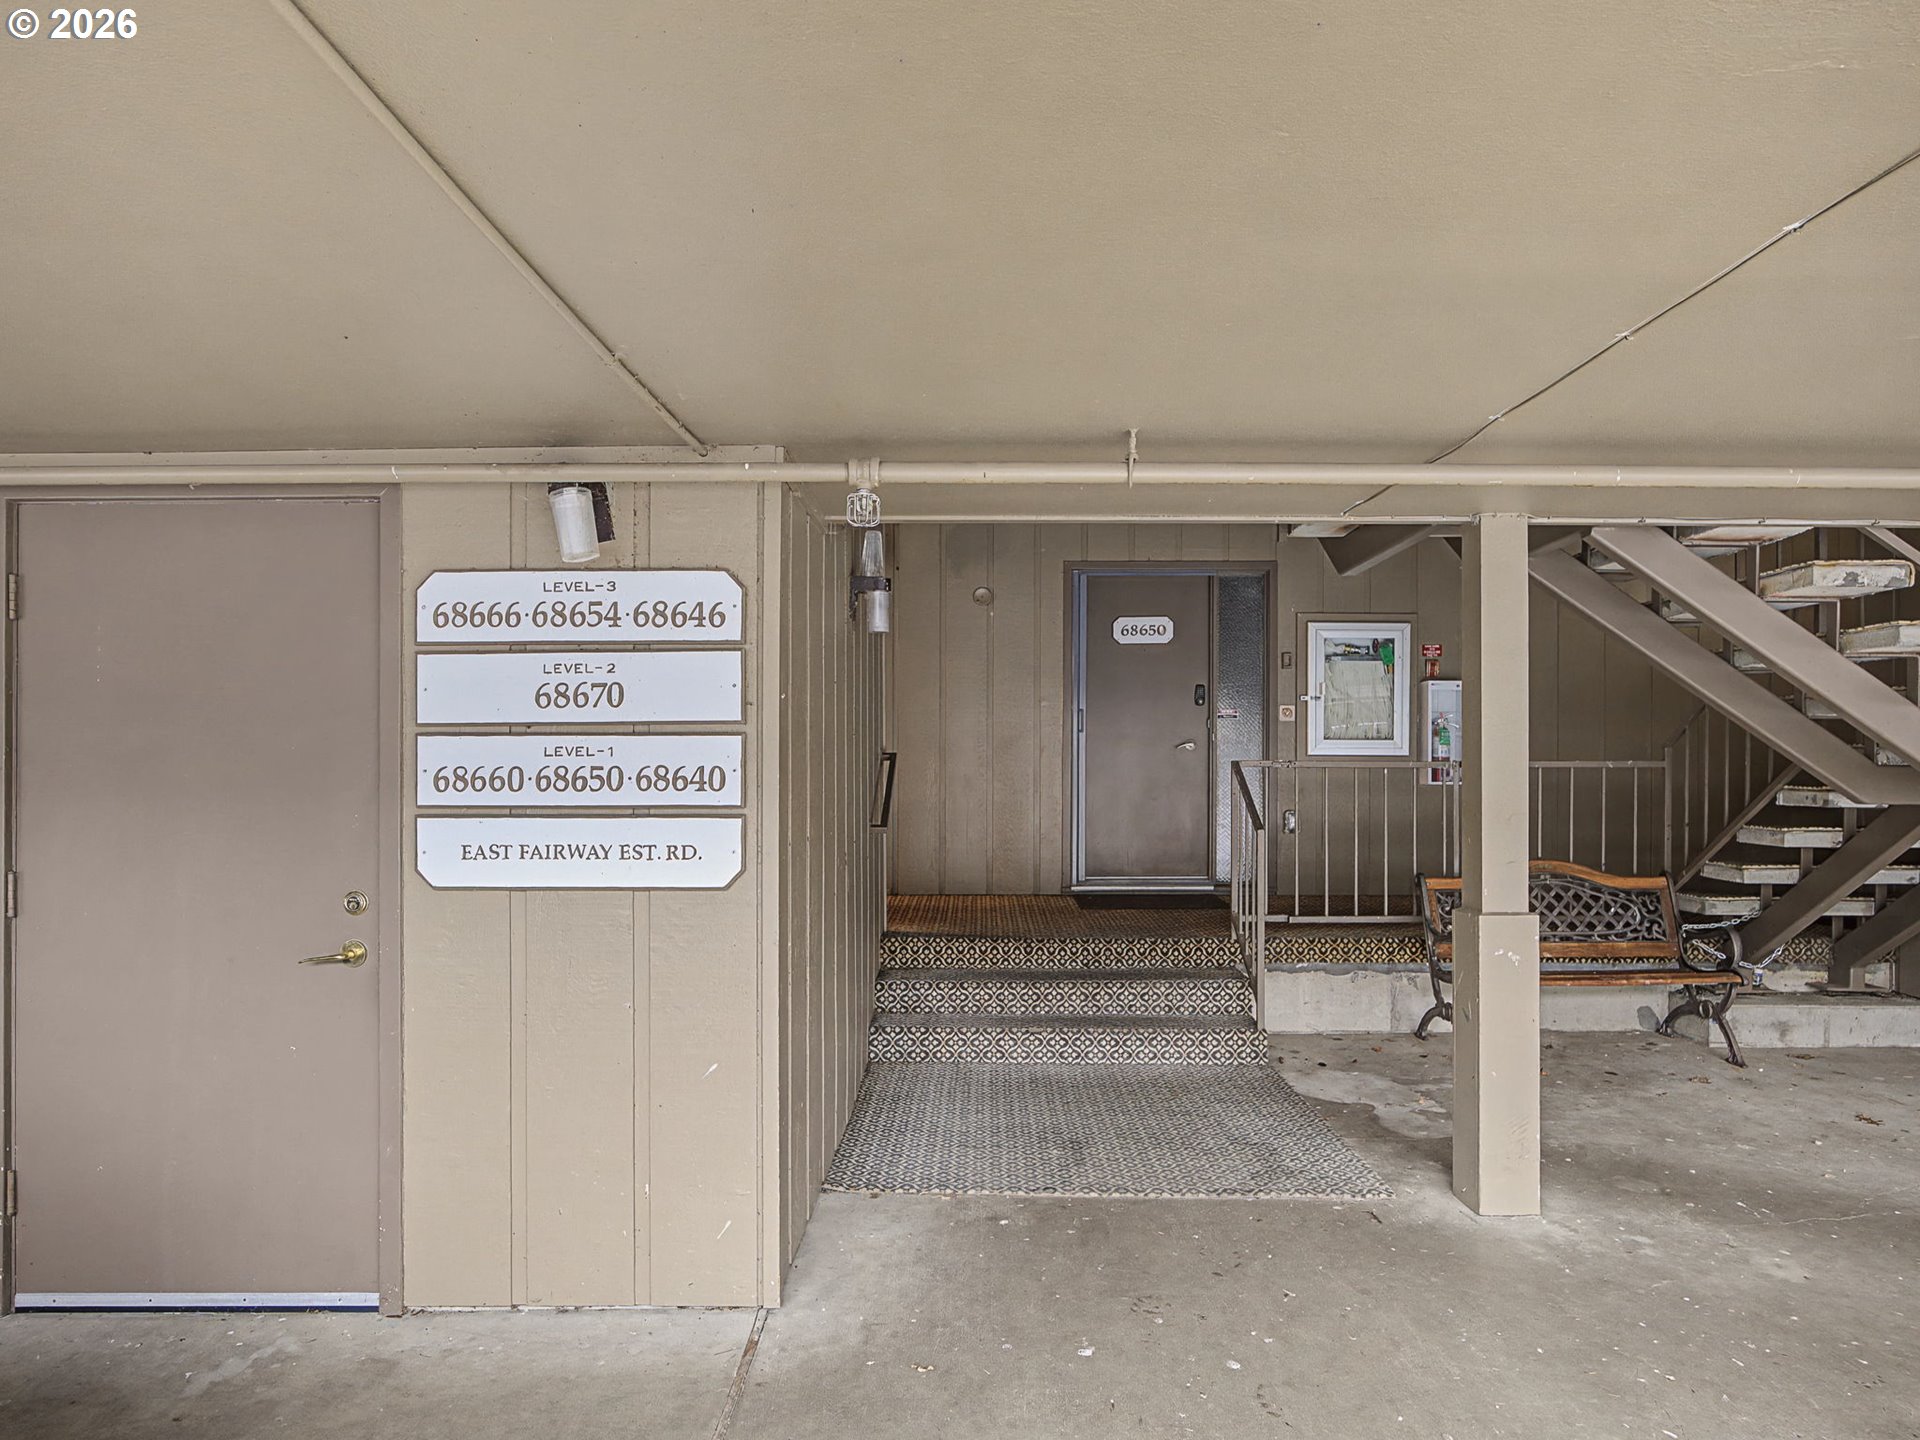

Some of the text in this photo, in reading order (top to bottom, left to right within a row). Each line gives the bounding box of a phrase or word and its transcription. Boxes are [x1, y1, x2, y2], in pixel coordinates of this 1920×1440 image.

[543, 581, 617, 593] LEVEL-3
[1120, 624, 1167, 637] 68650
[543, 663, 616, 675] LEVEL-2
[534, 681, 625, 709] 68670
[544, 746, 614, 758] LEVEL-1
[461, 844, 702, 861] EAST FAIRWAY EST. RD.
